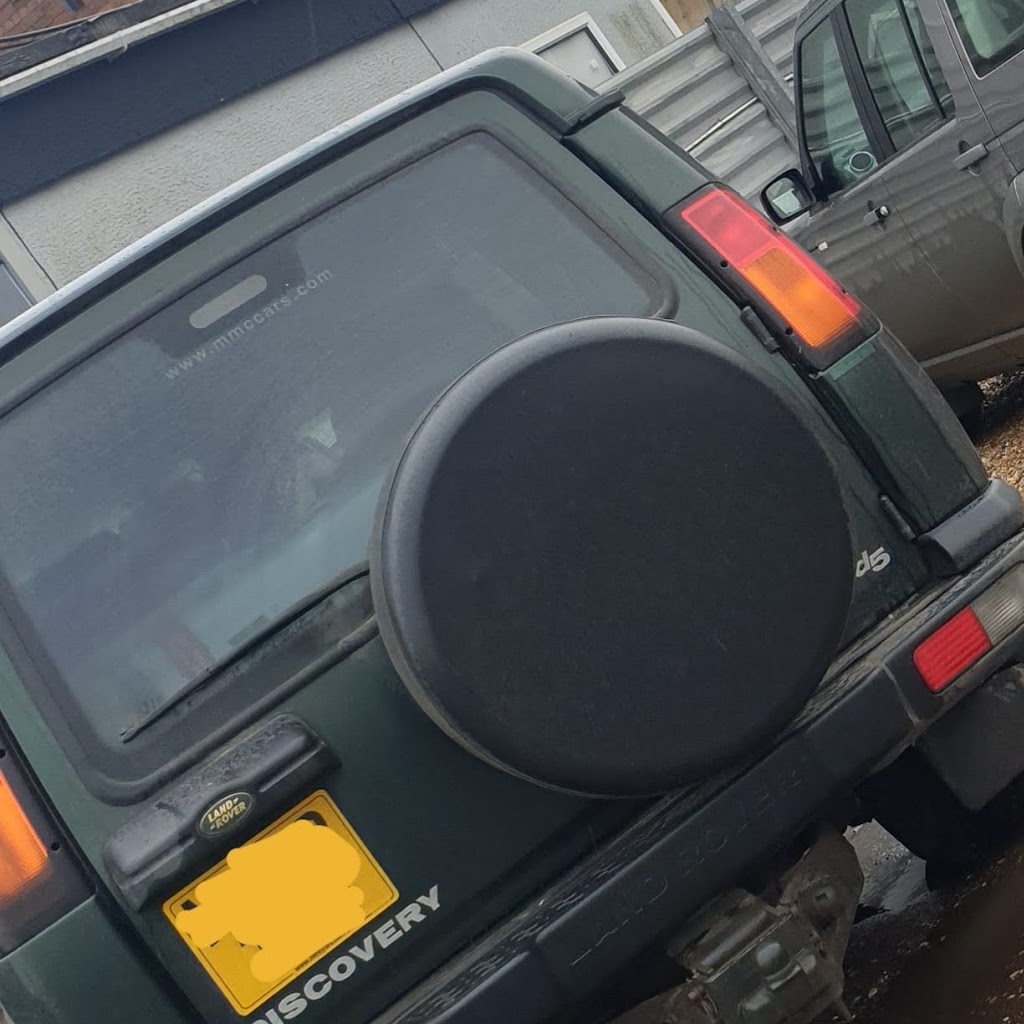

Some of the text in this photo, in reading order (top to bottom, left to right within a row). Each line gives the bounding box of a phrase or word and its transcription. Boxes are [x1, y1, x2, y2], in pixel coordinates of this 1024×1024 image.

[207, 799, 234, 823] LAND
[215, 801, 246, 829] ROVER
[251, 884, 441, 1024] ISCOVERY
